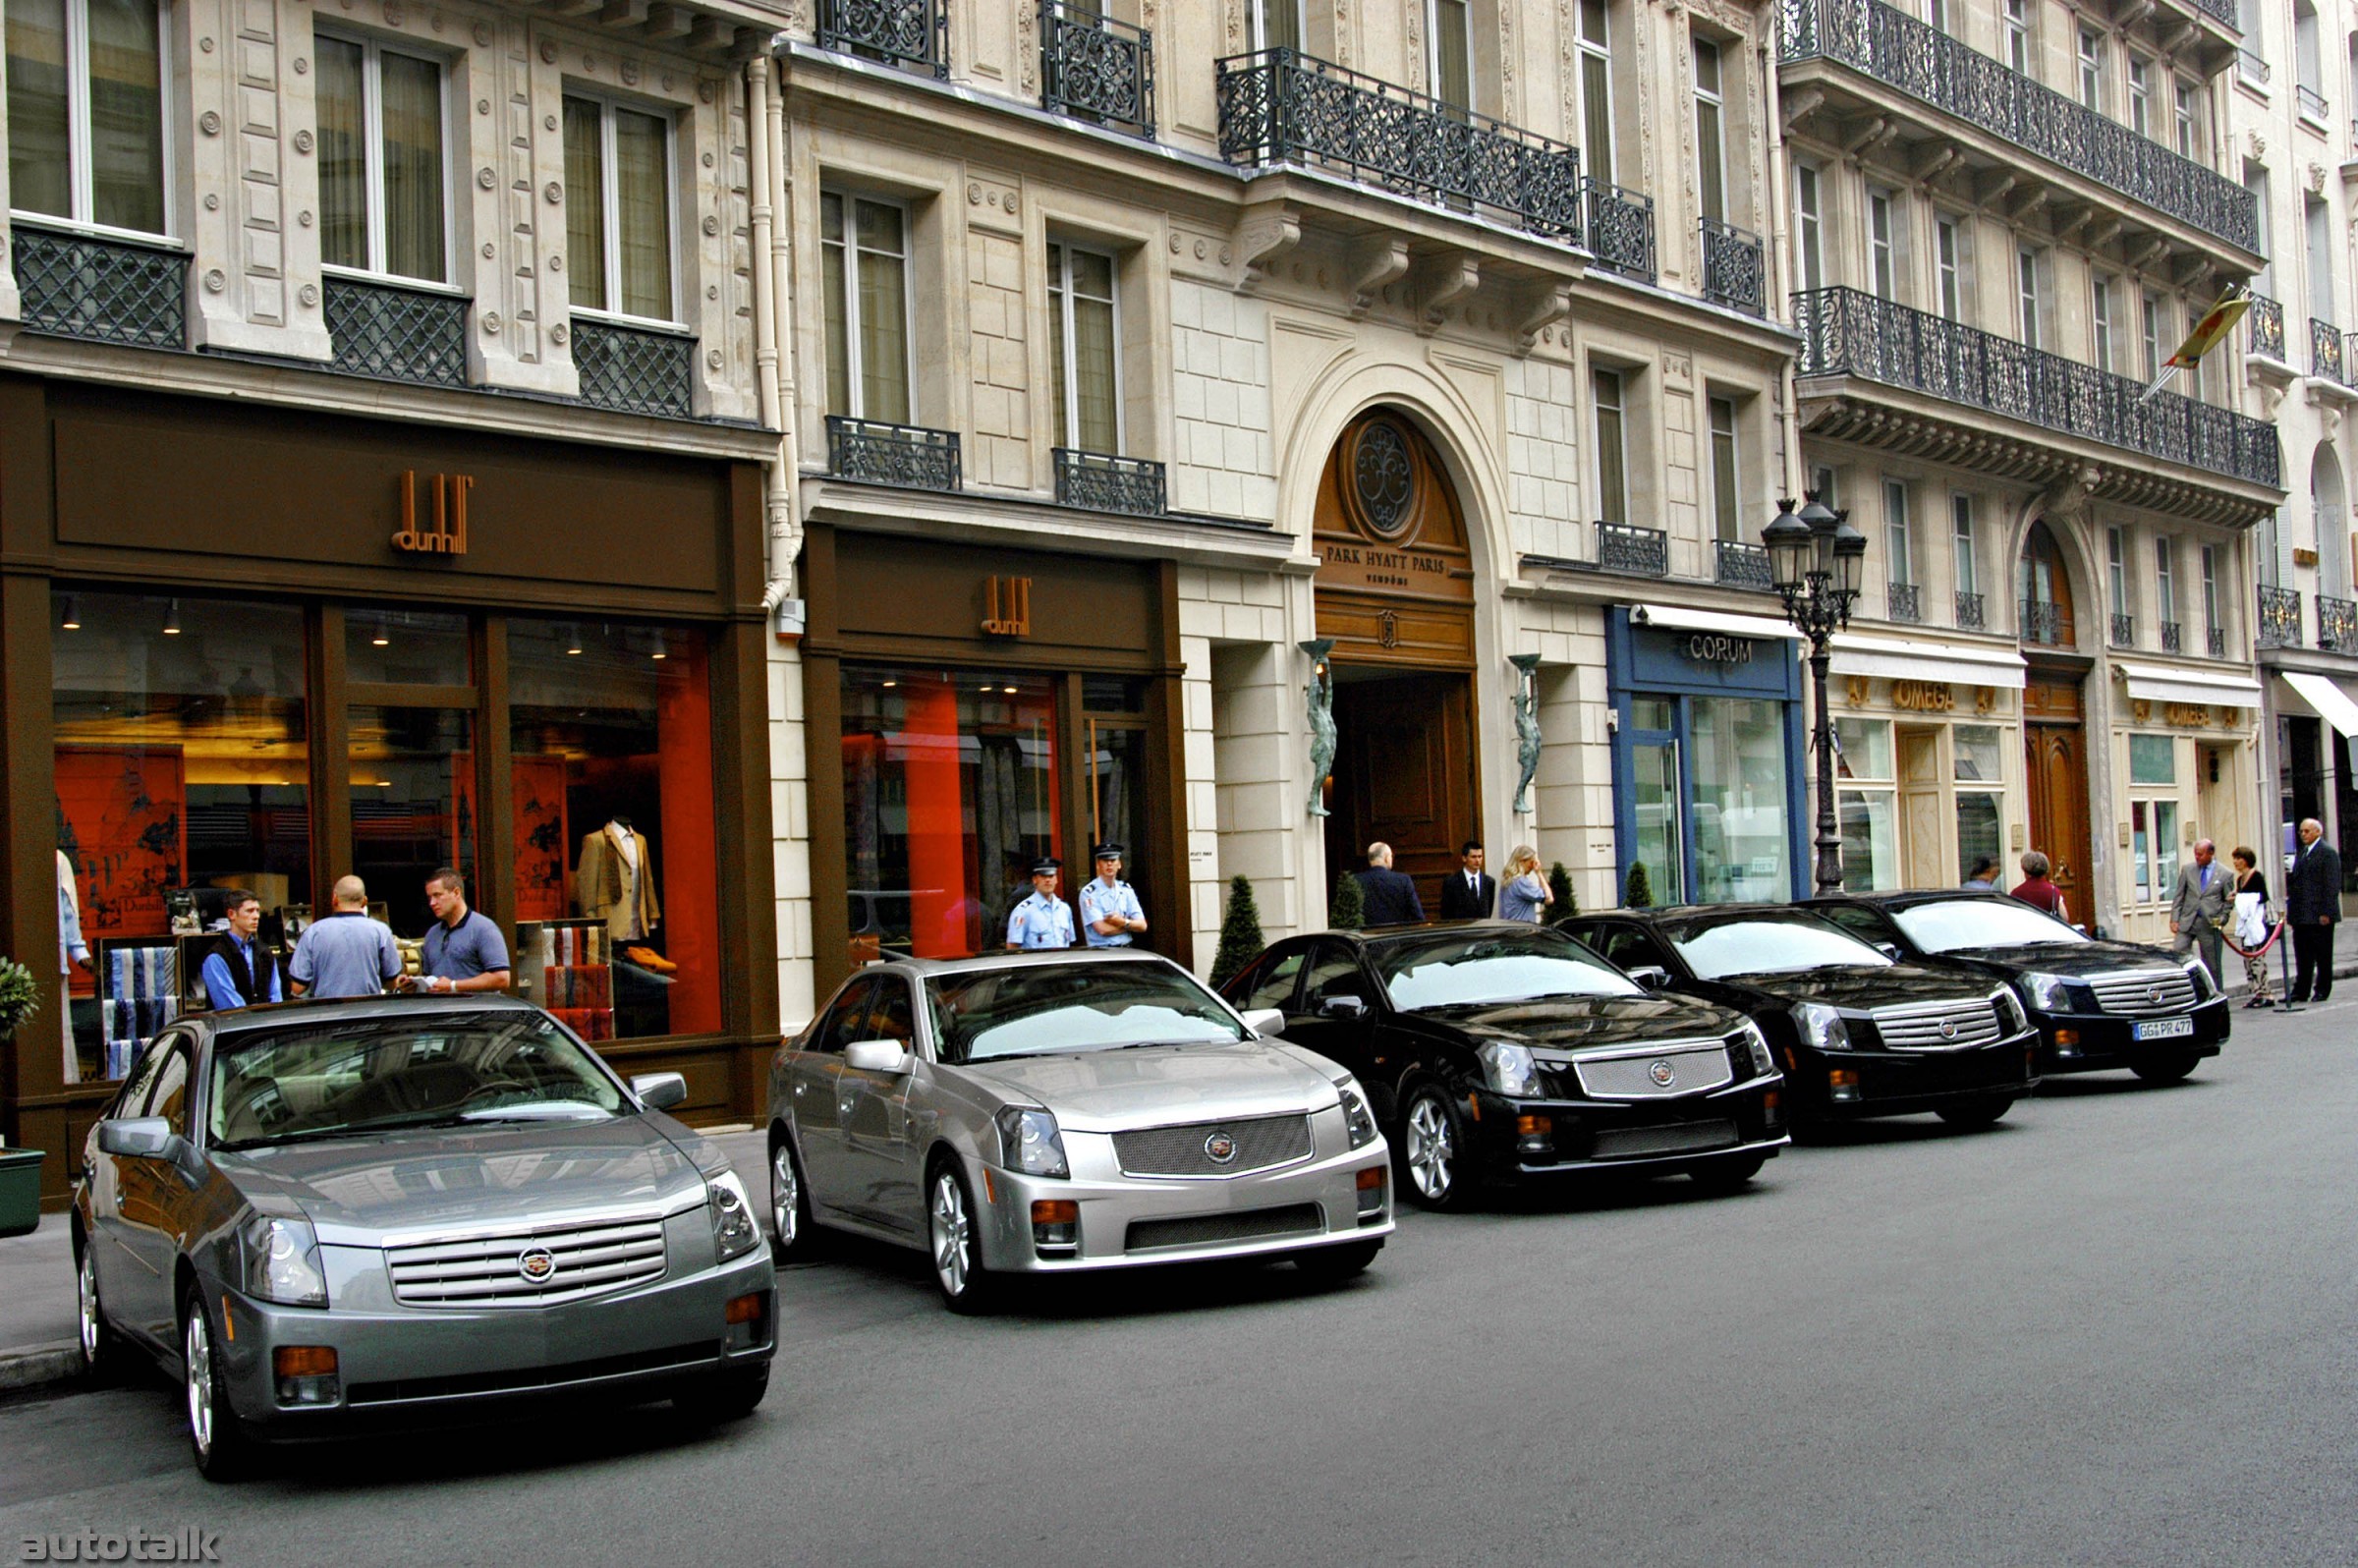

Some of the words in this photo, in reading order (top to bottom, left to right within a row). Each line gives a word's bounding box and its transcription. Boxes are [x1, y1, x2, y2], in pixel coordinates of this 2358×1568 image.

[393, 470, 473, 554] dunhill
[1327, 546, 1361, 564] PARK
[1367, 551, 1407, 569] HYATT
[1413, 557, 1444, 574] PARIS
[982, 575, 1032, 636] dunhill
[1691, 635, 1752, 662] CORUM
[1895, 680, 1955, 709] OMEGA
[2140, 1024, 2155, 1037] GG
[2161, 1022, 2173, 1036] PR
